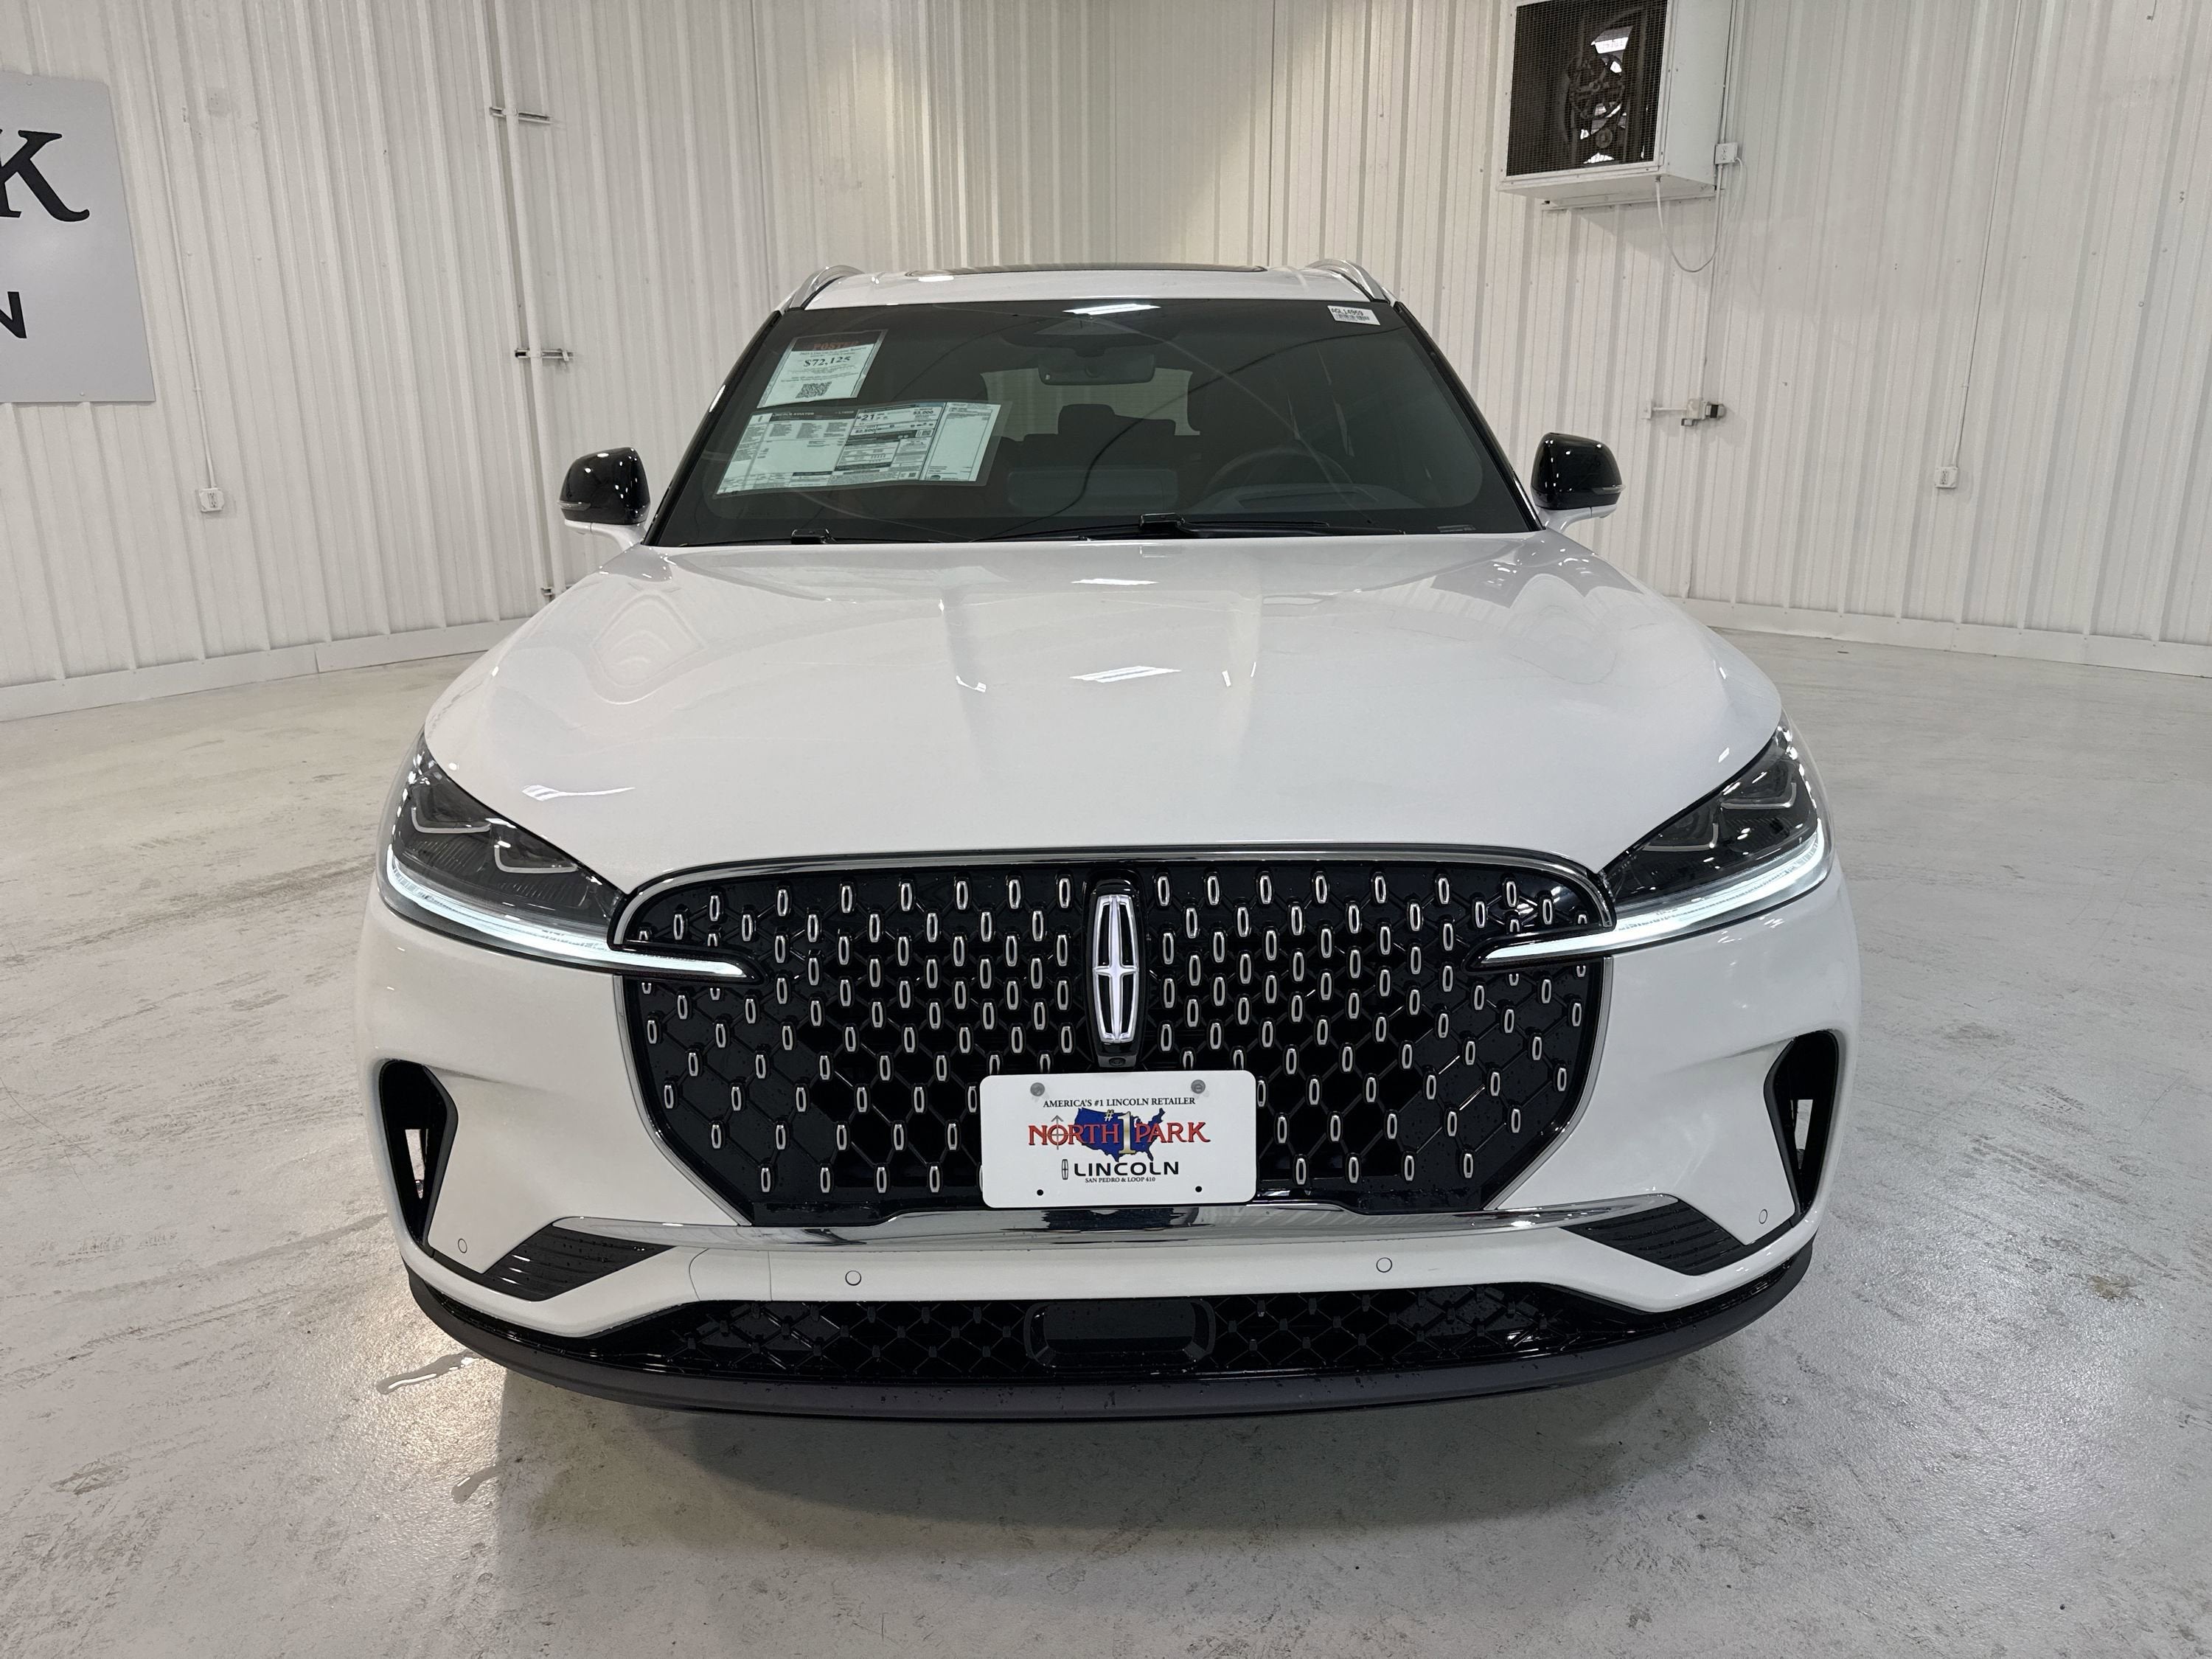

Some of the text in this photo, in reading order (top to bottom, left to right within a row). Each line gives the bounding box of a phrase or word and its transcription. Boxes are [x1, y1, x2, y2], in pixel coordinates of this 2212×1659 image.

[803, 356, 851, 367] $72,125
[1043, 1097, 1196, 1107] AMERICA'S #1 LINCOLN RETAILER
[1028, 1121, 1211, 1146] NORTH PARK
[1074, 1161, 1179, 1177] LINCOLN
